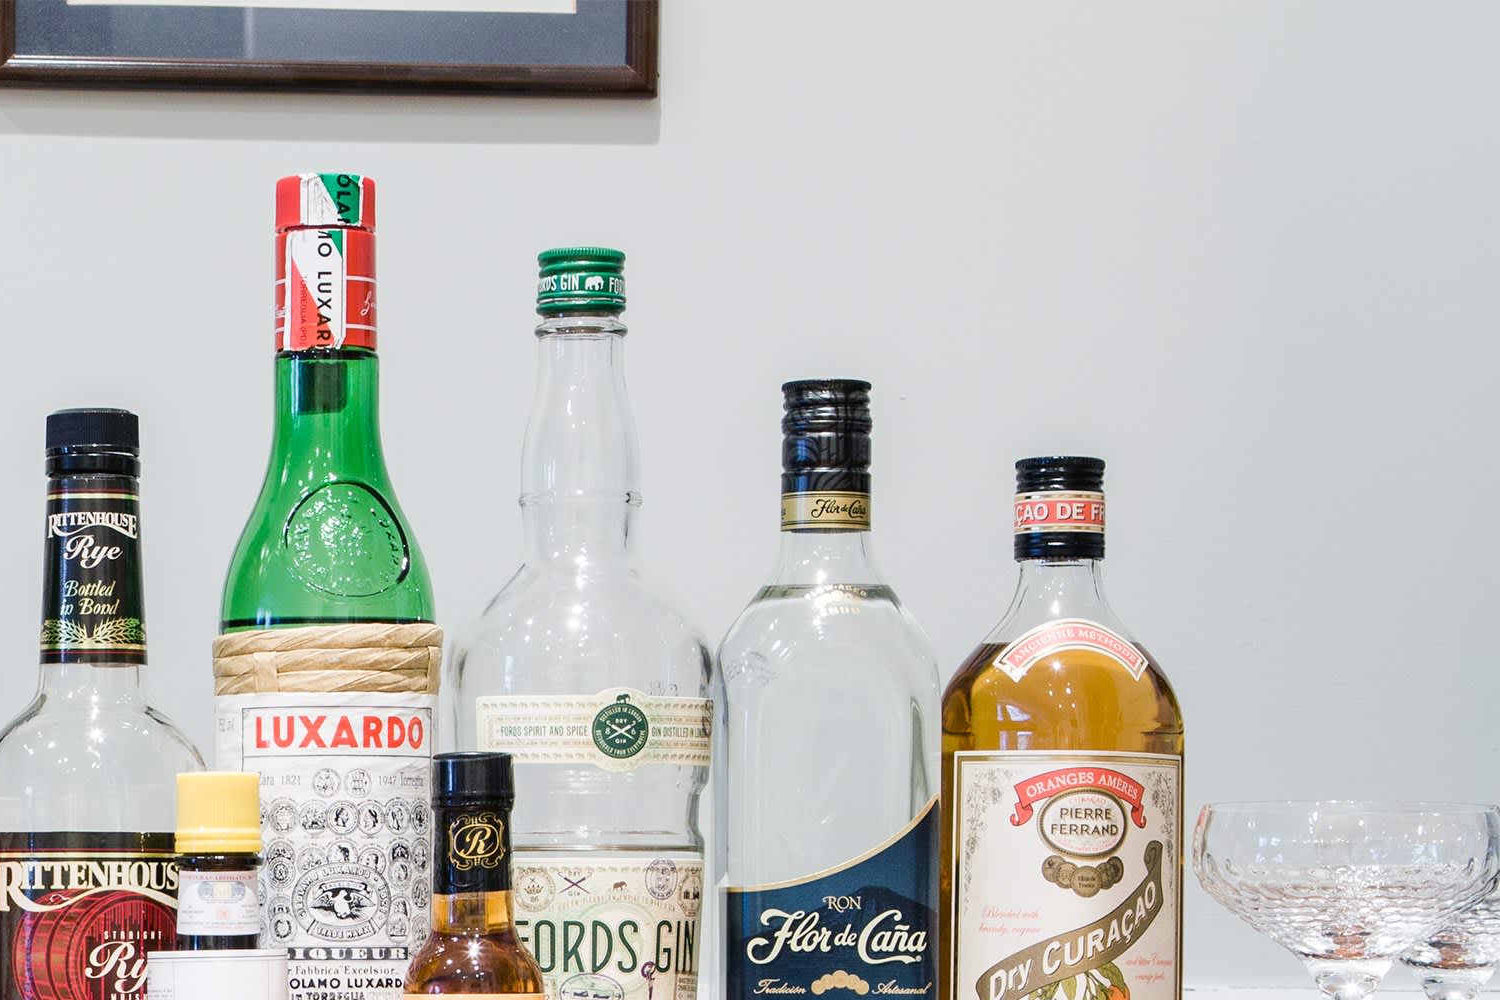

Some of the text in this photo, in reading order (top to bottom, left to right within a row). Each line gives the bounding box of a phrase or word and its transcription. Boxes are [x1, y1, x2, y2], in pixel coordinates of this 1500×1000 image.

[561, 274, 580, 291] GIN
[811, 498, 841, 519] Flor
[841, 502, 848, 513] de
[1056, 502, 1085, 520] DE
[48, 512, 138, 539] RITTENHOUSE
[63, 534, 124, 569] Rye
[64, 580, 116, 598] Bottled
[60, 597, 120, 615] in Bond
[1013, 627, 1137, 665] ANCIENNE MÉTHODE
[255, 715, 424, 750] LUXARDO
[500, 725, 588, 737] FORDS SPIRIT AND SPICE
[604, 727, 611, 735] 8
[651, 725, 662, 738] GIN
[281, 774, 301, 786] 1821
[1026, 772, 1139, 800] ORANGES AMÈRES
[1060, 808, 1112, 820] PIERRE
[1050, 823, 1119, 836] FERRAND
[460, 825, 493, 855] R
[821, 895, 862, 912] RON
[104, 930, 162, 940] STRAIGHT
[747, 908, 927, 965] Flor de Caña
[1042, 880, 1157, 975] CURAÇAO
[288, 947, 407, 960] IQUEUR
[515, 919, 696, 974] FORDS GIN
[85, 941, 148, 994] Ry
[295, 965, 339, 975] Fabbrica
[290, 978, 403, 989] OLAMO LUXARD
[753, 978, 932, 996] Tradición Artesanal
